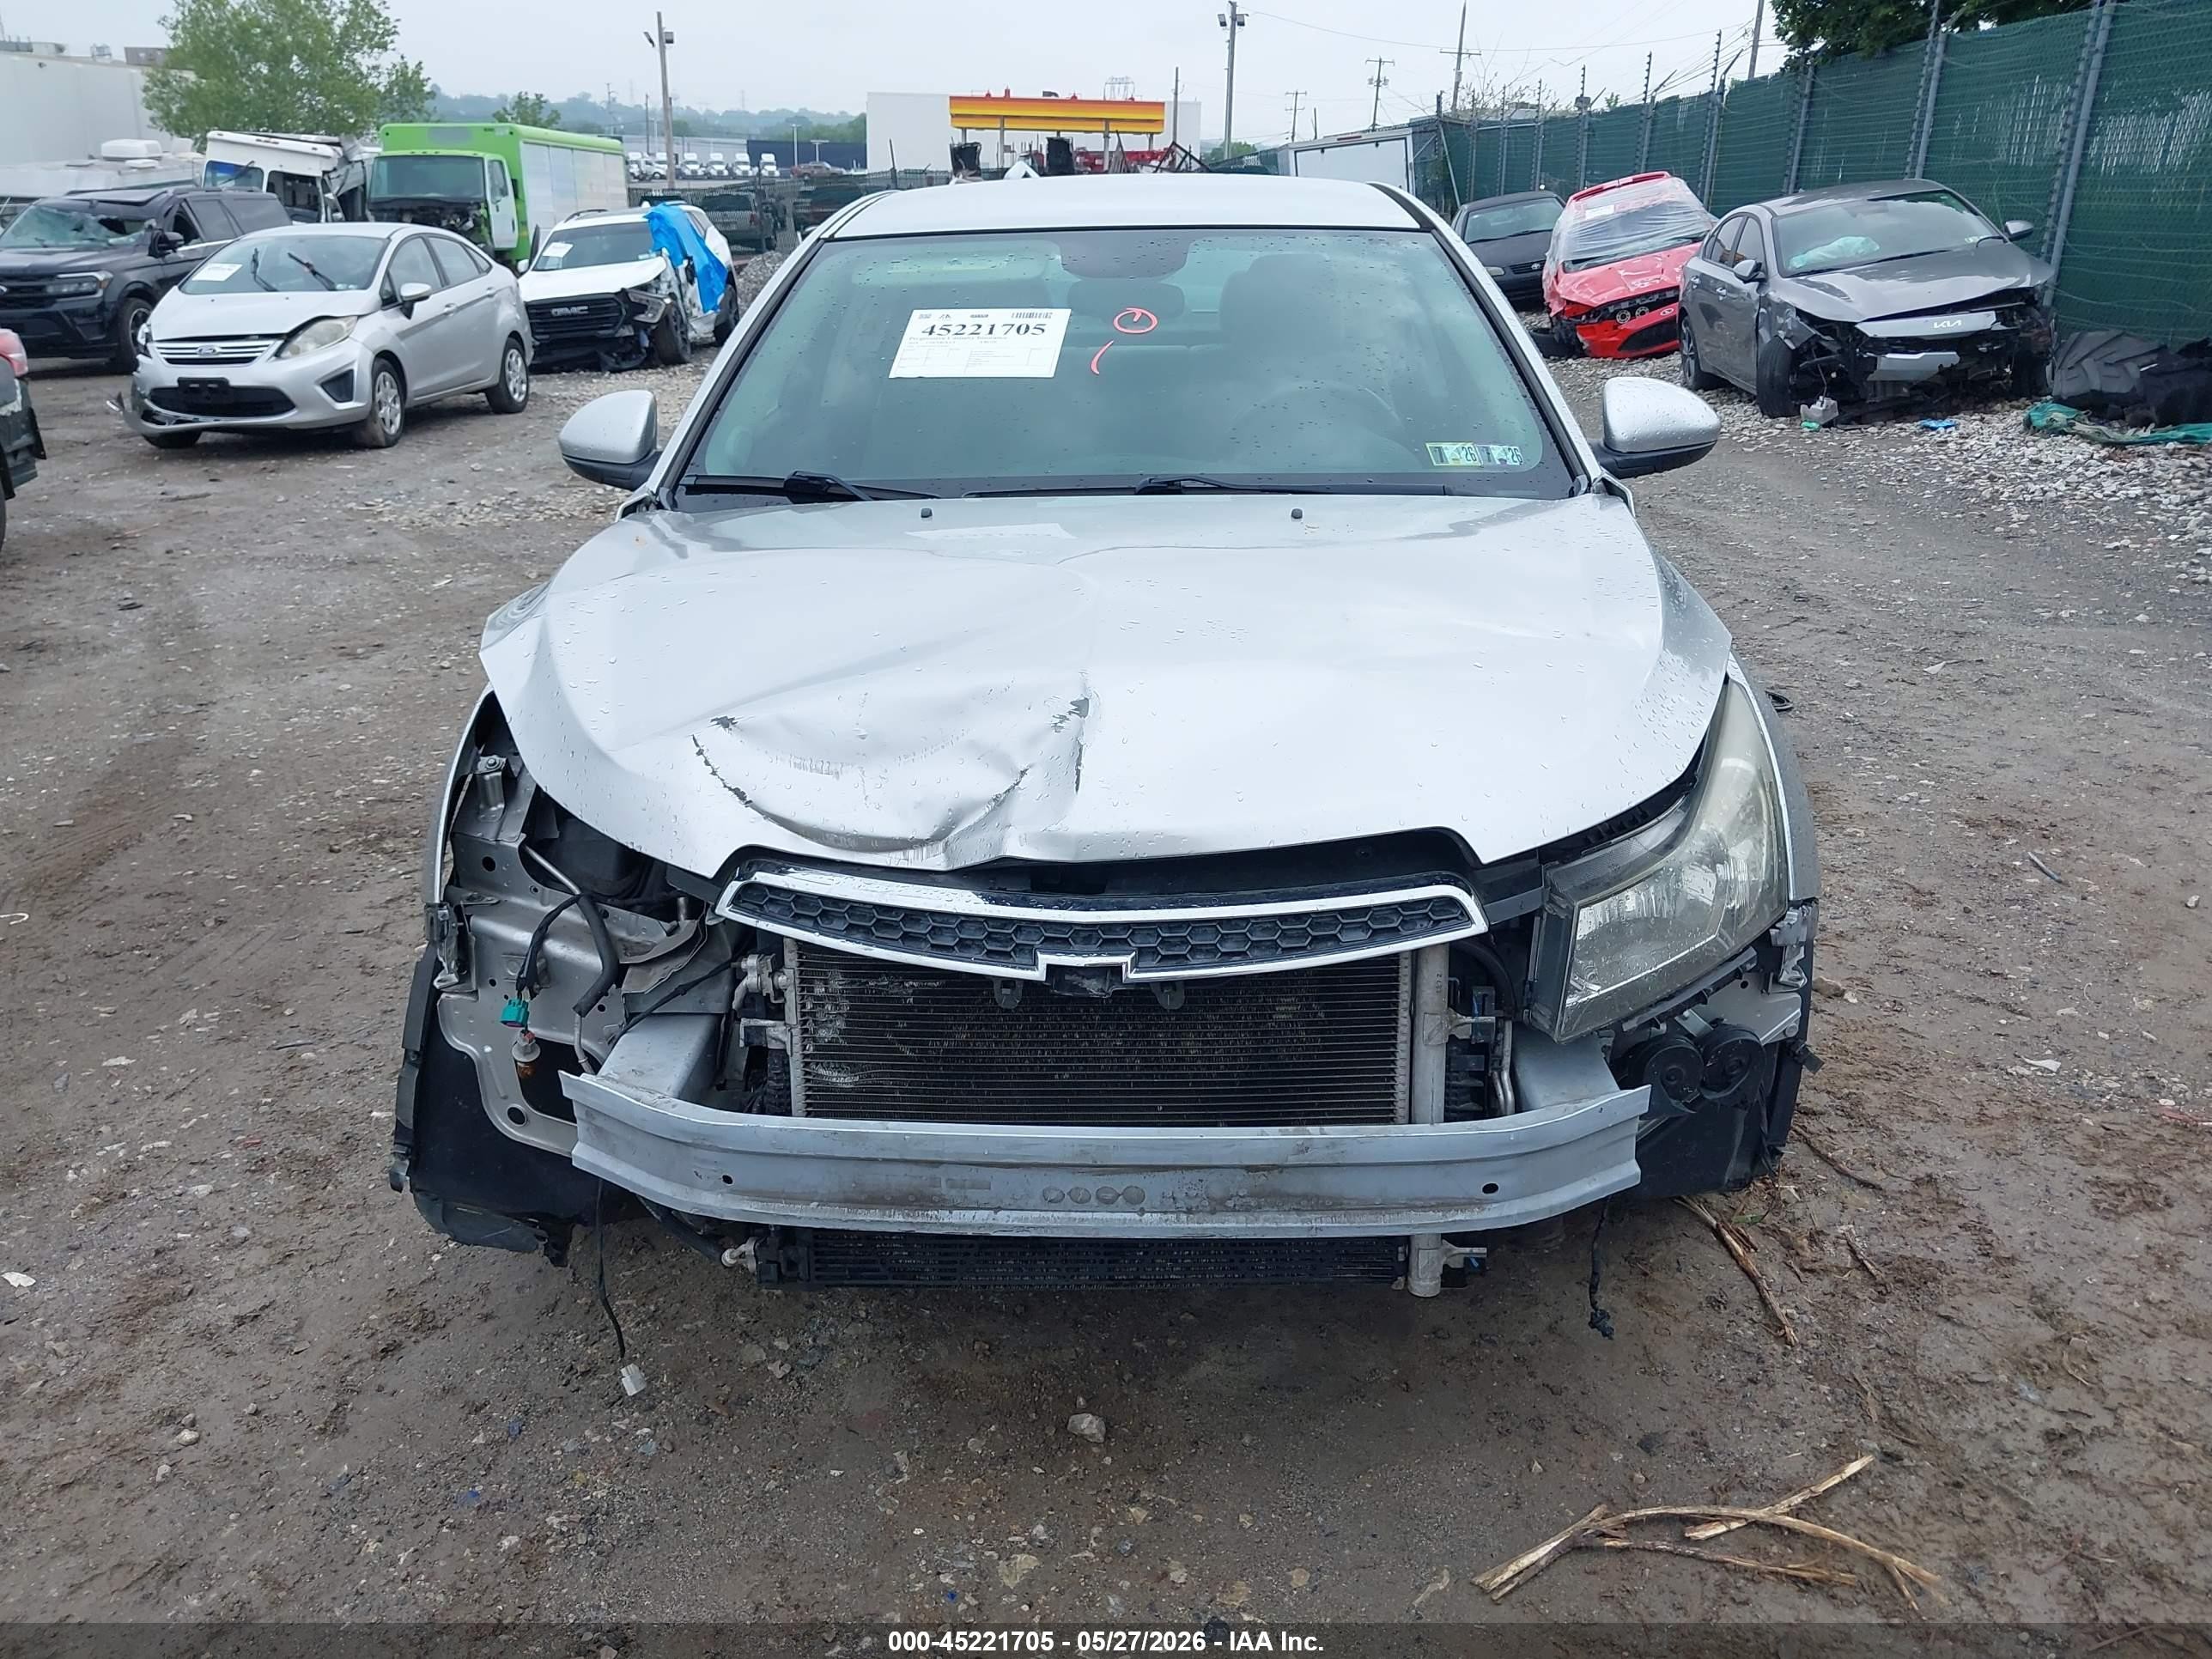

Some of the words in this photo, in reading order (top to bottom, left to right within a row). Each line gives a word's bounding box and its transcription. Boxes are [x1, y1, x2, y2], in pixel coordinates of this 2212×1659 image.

[550, 306, 589, 317] GMC
[921, 323, 1047, 336] 45221705
[1933, 319, 1962, 329] KIA
[1462, 446, 1477, 462] 26
[1508, 447, 1523, 465] 26
